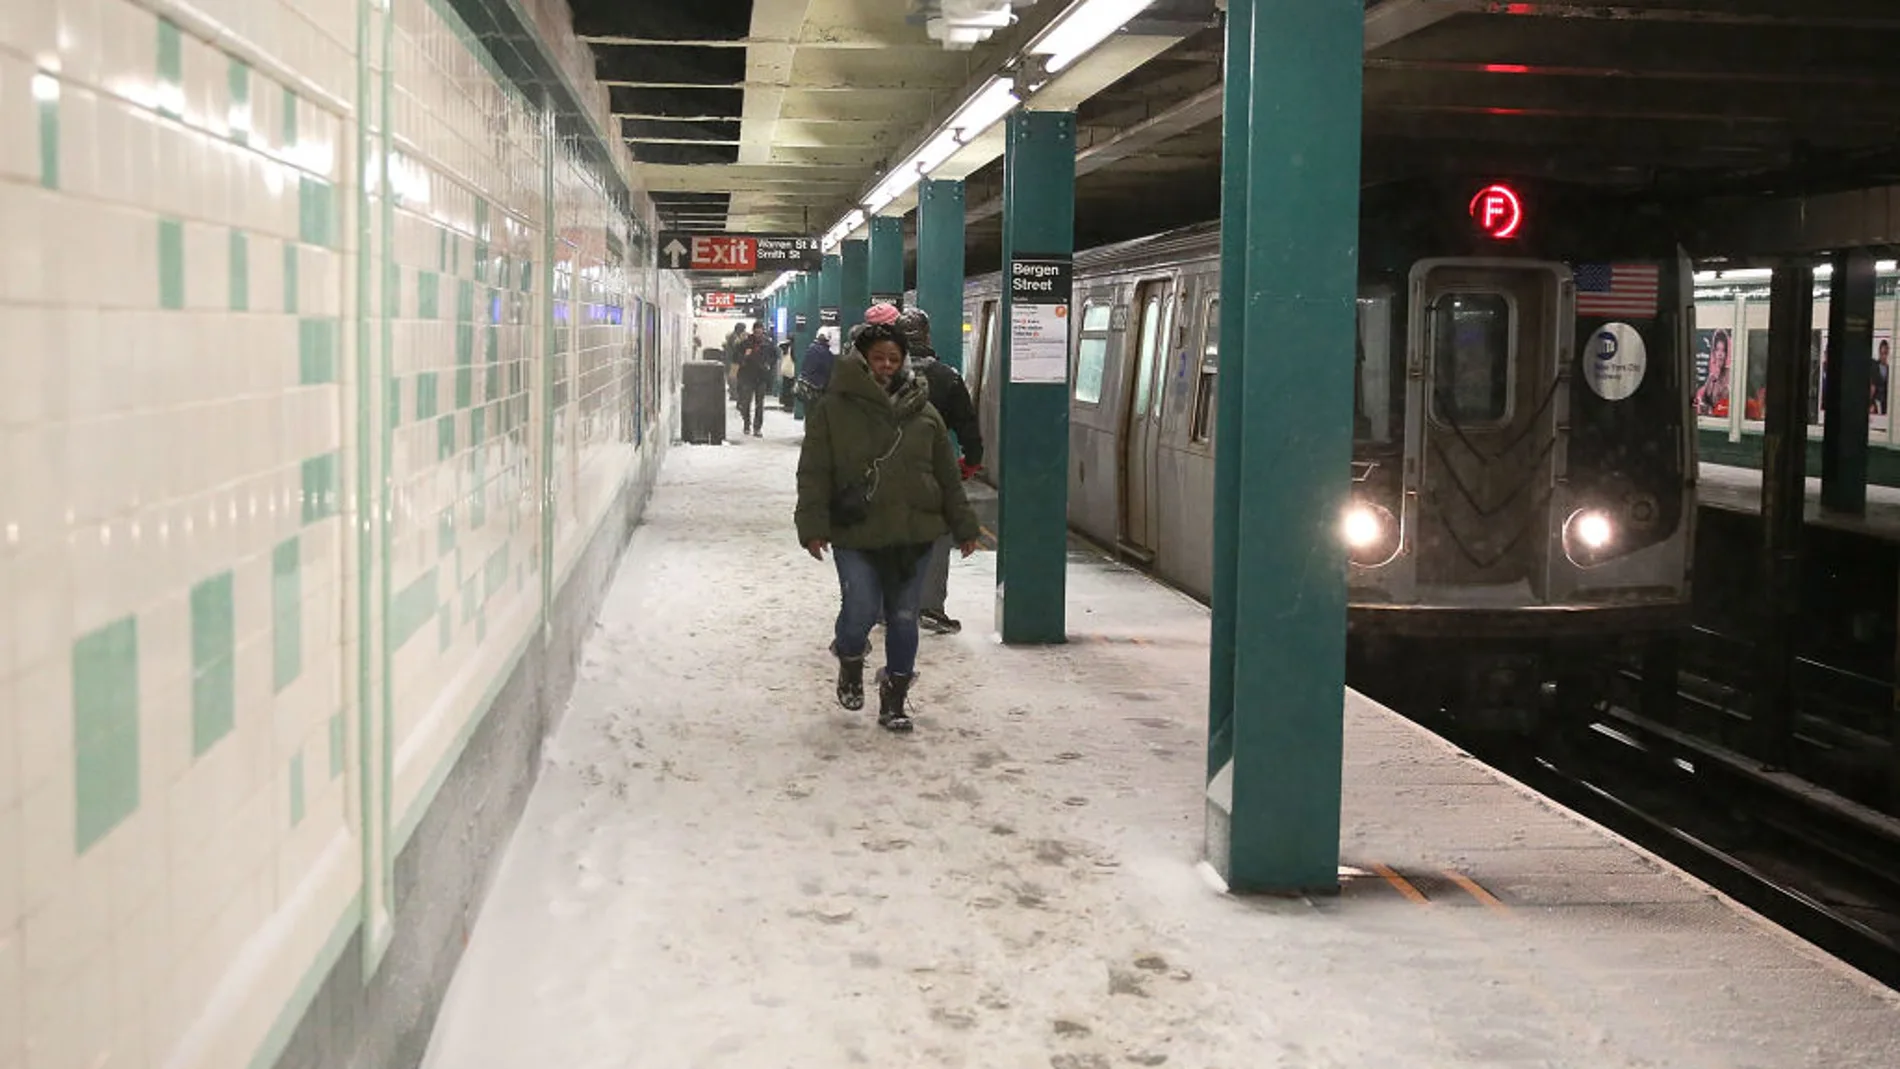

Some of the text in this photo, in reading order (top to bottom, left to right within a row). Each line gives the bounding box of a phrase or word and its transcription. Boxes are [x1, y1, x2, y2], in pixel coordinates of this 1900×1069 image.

[1486, 197, 1504, 227] F
[692, 237, 749, 264] Exit
[795, 240, 808, 250] St
[810, 239, 819, 250] &
[757, 249, 801, 259] Smith St
[1012, 262, 1060, 277] Bergen
[1012, 277, 1053, 291] Street
[706, 292, 731, 305] Exit
